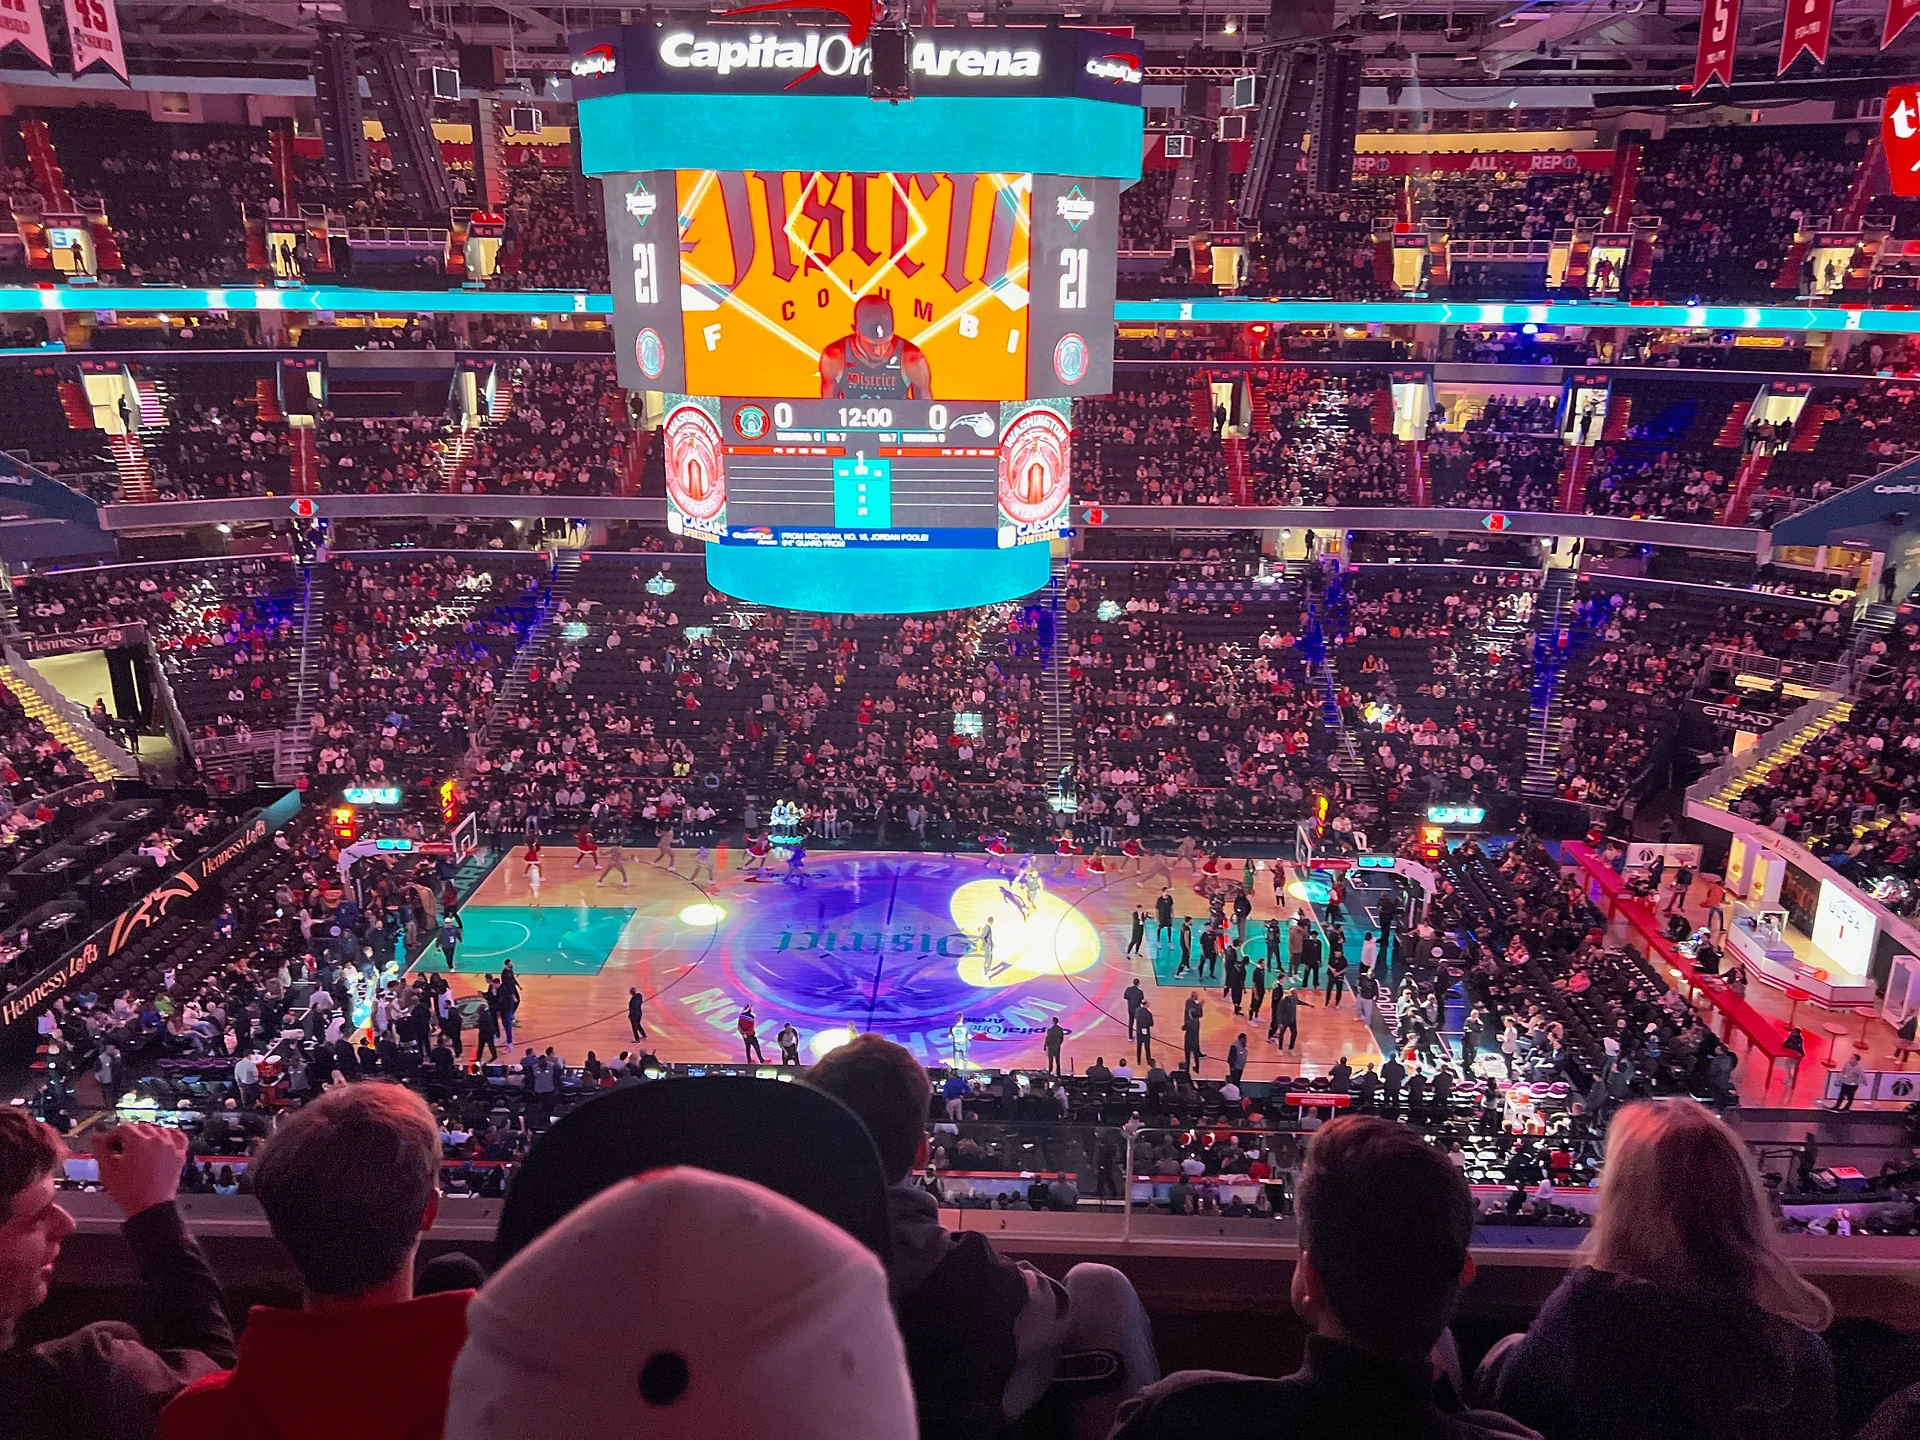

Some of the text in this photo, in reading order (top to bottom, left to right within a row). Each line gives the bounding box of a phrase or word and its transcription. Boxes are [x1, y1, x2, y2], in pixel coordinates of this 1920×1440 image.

[912, 43, 1041, 76] Arena
[1468, 157, 1498, 171] ALL
[633, 243, 658, 304] 21
[1059, 248, 1088, 309] 21
[847, 371, 897, 387] District
[774, 402, 793, 428] 0
[838, 407, 893, 428] 12:00
[928, 404, 948, 431] 0
[1003, 414, 1068, 448] WASHINGTON
[1016, 515, 1070, 536] CAESARS
[27, 636, 89, 653] Hennessy
[1702, 705, 1773, 726] ETIHAD
[202, 839, 245, 877] Hennessy
[2, 943, 98, 1025] Hennessy Lofts
